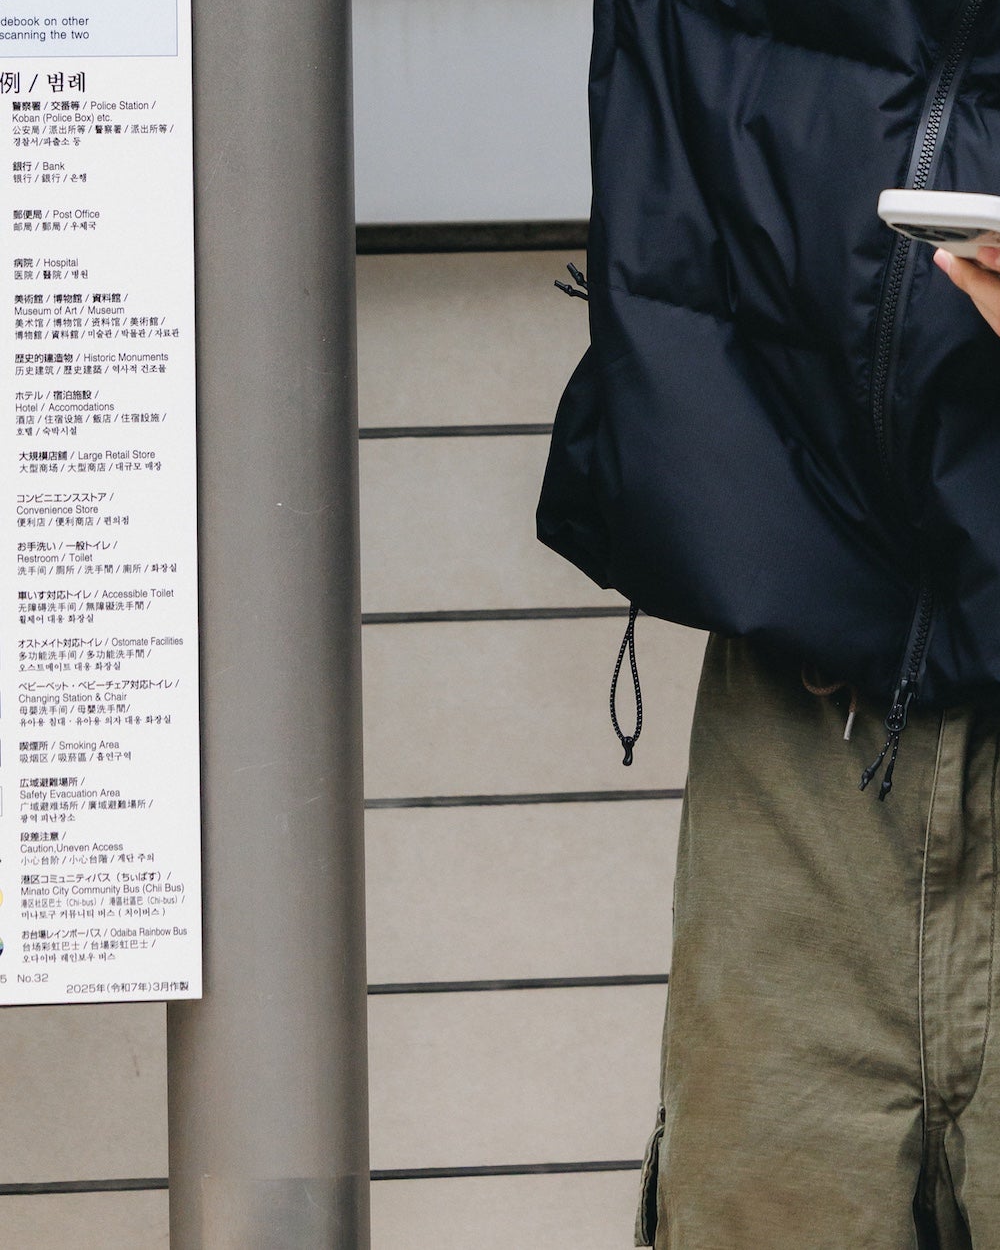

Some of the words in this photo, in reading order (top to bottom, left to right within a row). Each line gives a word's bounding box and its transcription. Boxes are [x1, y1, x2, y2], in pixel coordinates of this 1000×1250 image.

[0, 16, 40, 26] debook
[44, 18, 57, 26] on
[62, 16, 89, 26] other
[0, 30, 46, 42] scanning
[50, 30, 67, 39] the
[71, 30, 89, 39] two
[91, 101, 116, 110] Police
[119, 101, 149, 110] Station
[12, 113, 40, 123] Koban
[43, 113, 72, 124] (Police
[75, 113, 94, 124] Box)
[97, 114, 112, 122] etc.
[43, 162, 65, 171] Bank
[53, 210, 72, 219] Post
[75, 209, 100, 219] Office
[44, 258, 78, 269] Hospital
[15, 307, 51, 315] Museum
[54, 306, 62, 315] of
[65, 306, 77, 315] Art
[88, 305, 124, 314] Museum
[84, 353, 116, 362] Historic
[118, 353, 168, 362] Monuments
[15, 391, 43, 400] ホテル
[15, 403, 38, 412] Hotel
[48, 402, 114, 412] Accomodations
[78, 451, 102, 462] Large
[106, 450, 129, 459] Retail
[132, 450, 155, 459] Store
[17, 493, 107, 503] コンビニエンスストア
[16, 505, 73, 515] Convenience
[76, 504, 98, 514] Store
[17, 542, 56, 552] お手洗い
[66, 541, 110, 551] 一般トイレ
[17, 554, 59, 563] Restroom
[69, 553, 93, 562] Toilet
[18, 590, 91, 600] 車いす対応トイレ
[102, 589, 148, 599] Accessible
[150, 588, 174, 597] Toilet
[18, 638, 102, 649] オストメイト対応トイレ
[112, 637, 148, 647] Ostomate
[151, 637, 183, 646] Facilities
[19, 694, 60, 706] Changing
[63, 693, 92, 702] Station
[95, 693, 101, 702] &
[104, 692, 127, 702] Chair
[59, 741, 96, 751] Smoking
[99, 740, 119, 749] Area
[20, 790, 47, 801] Safety
[50, 789, 97, 799] Evacuation
[100, 788, 120, 797] Area
[92, 843, 123, 852] Access
[21, 887, 50, 896] Minato
[52, 886, 69, 897] City
[72, 885, 122, 897] Community
[123, 884, 140, 893] Bus
[142, 883, 162, 894] (Chii
[165, 883, 184, 894] Bus)
[110, 928, 137, 937] Odaiba
[139, 927, 171, 936] Rainbow
[173, 926, 187, 936] Bus
[17, 973, 48, 983] No.32
